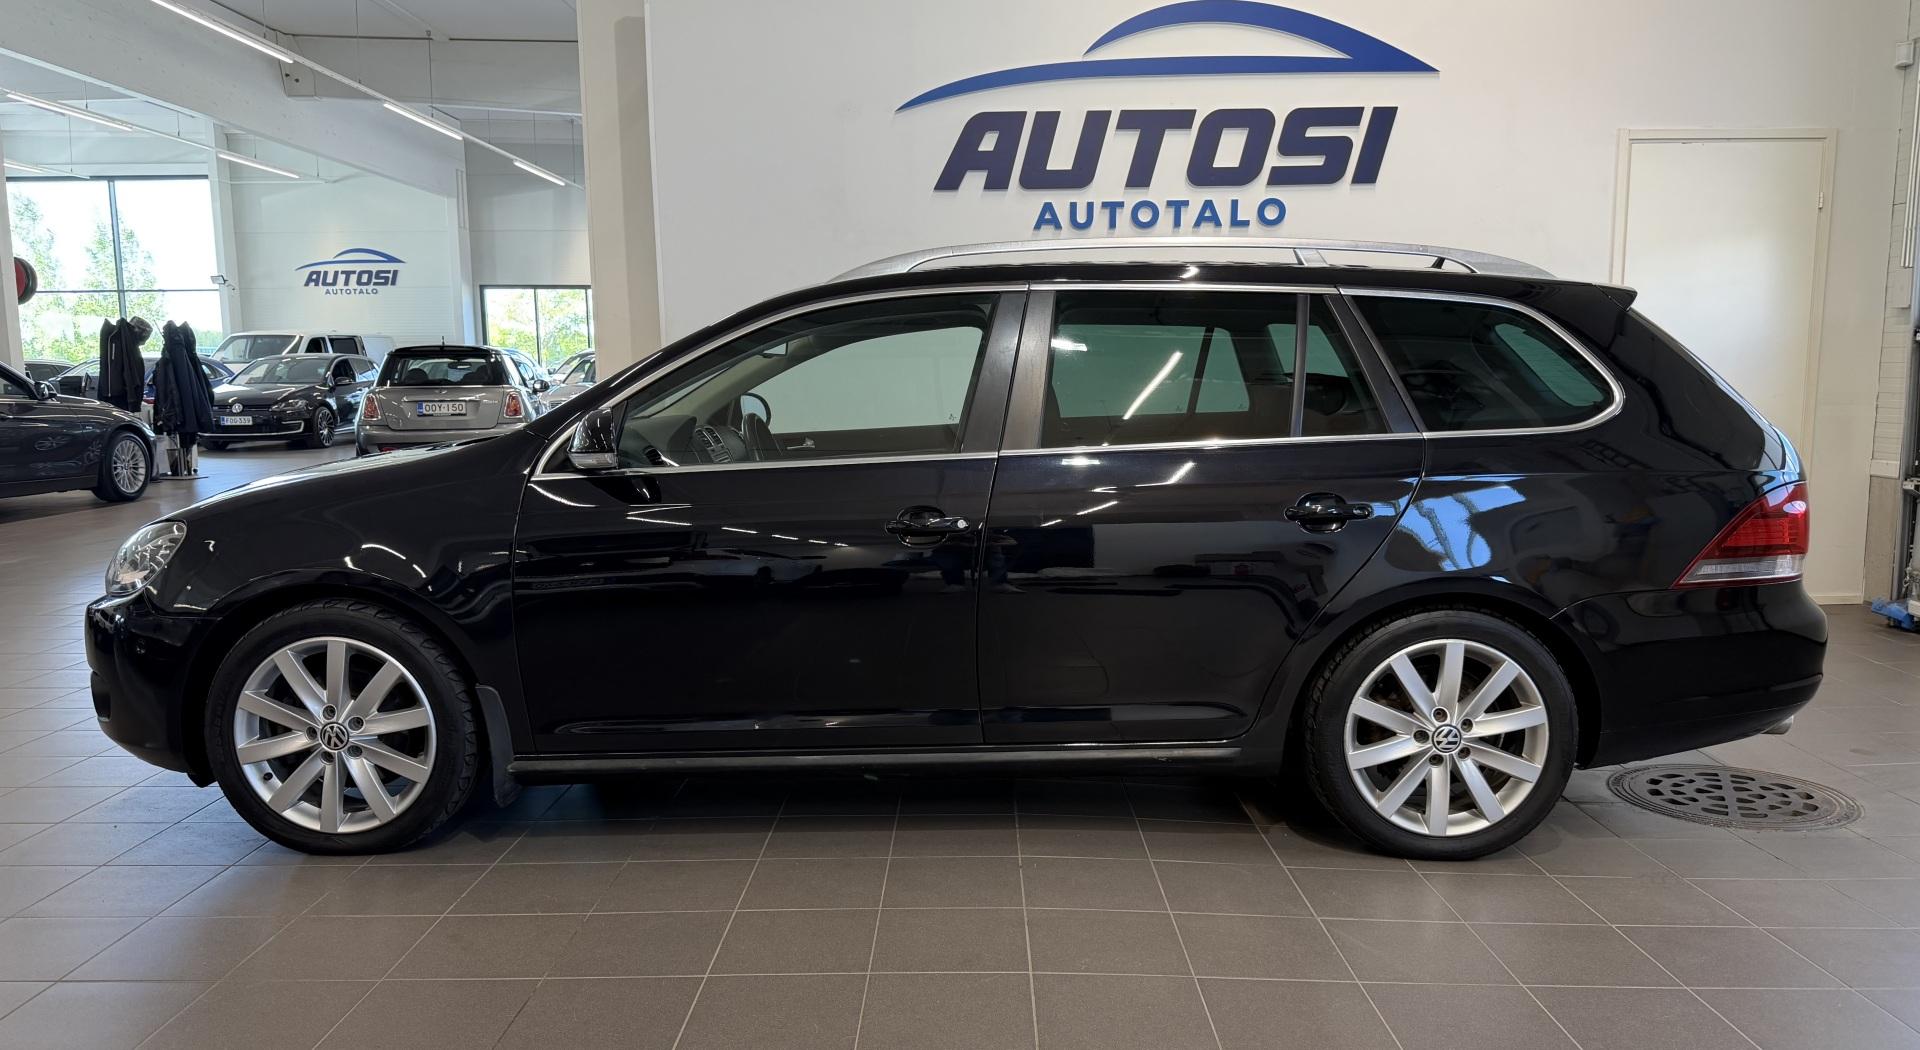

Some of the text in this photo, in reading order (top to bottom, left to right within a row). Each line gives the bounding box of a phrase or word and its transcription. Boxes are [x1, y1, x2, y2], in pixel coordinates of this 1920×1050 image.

[933, 106, 1399, 190] AUTOSI
[1033, 197, 1287, 230] AUTOTALO
[303, 269, 399, 287] AUTOSI
